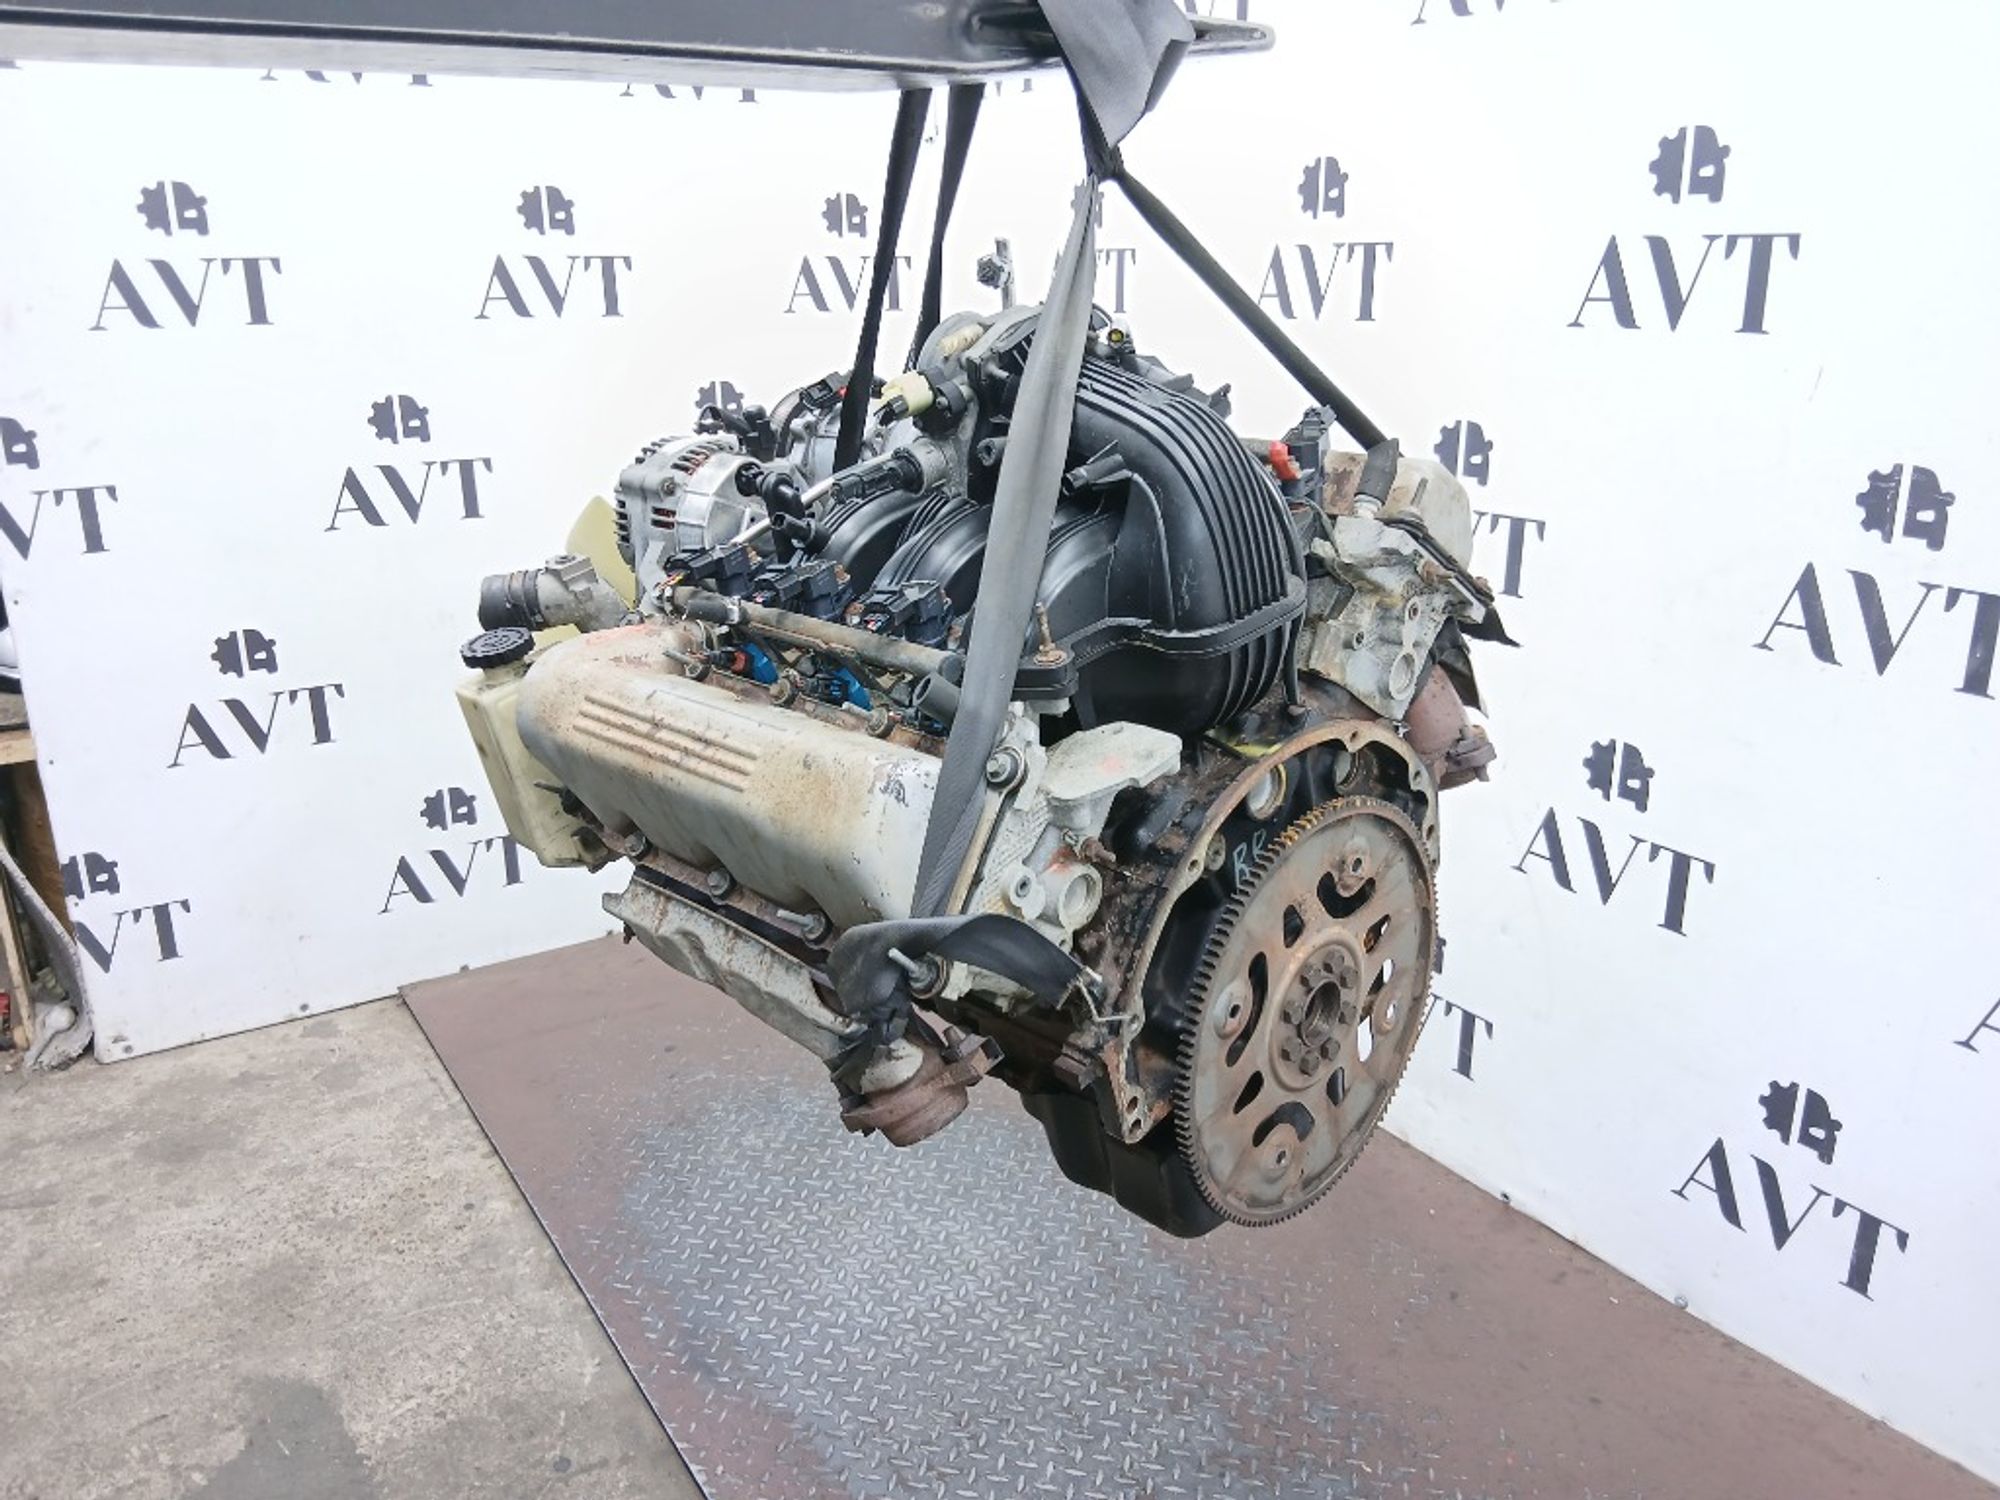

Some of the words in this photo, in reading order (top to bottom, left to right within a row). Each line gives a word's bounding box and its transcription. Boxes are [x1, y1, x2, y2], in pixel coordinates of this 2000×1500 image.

[89, 258, 281, 331] AVT
[475, 255, 632, 319] AVT
[784, 255, 912, 313] AVT
[1258, 242, 1394, 321] AVT
[1567, 233, 1801, 335] AVT
[0, 485, 118, 561] VT
[324, 457, 493, 533] AVT
[1752, 562, 2000, 700] AVT
[167, 683, 345, 769] AVT
[378, 835, 524, 915] AVT
[1511, 807, 1716, 937] AVT
[75, 899, 191, 974] VT
[1670, 1137, 1910, 1302] AVT
